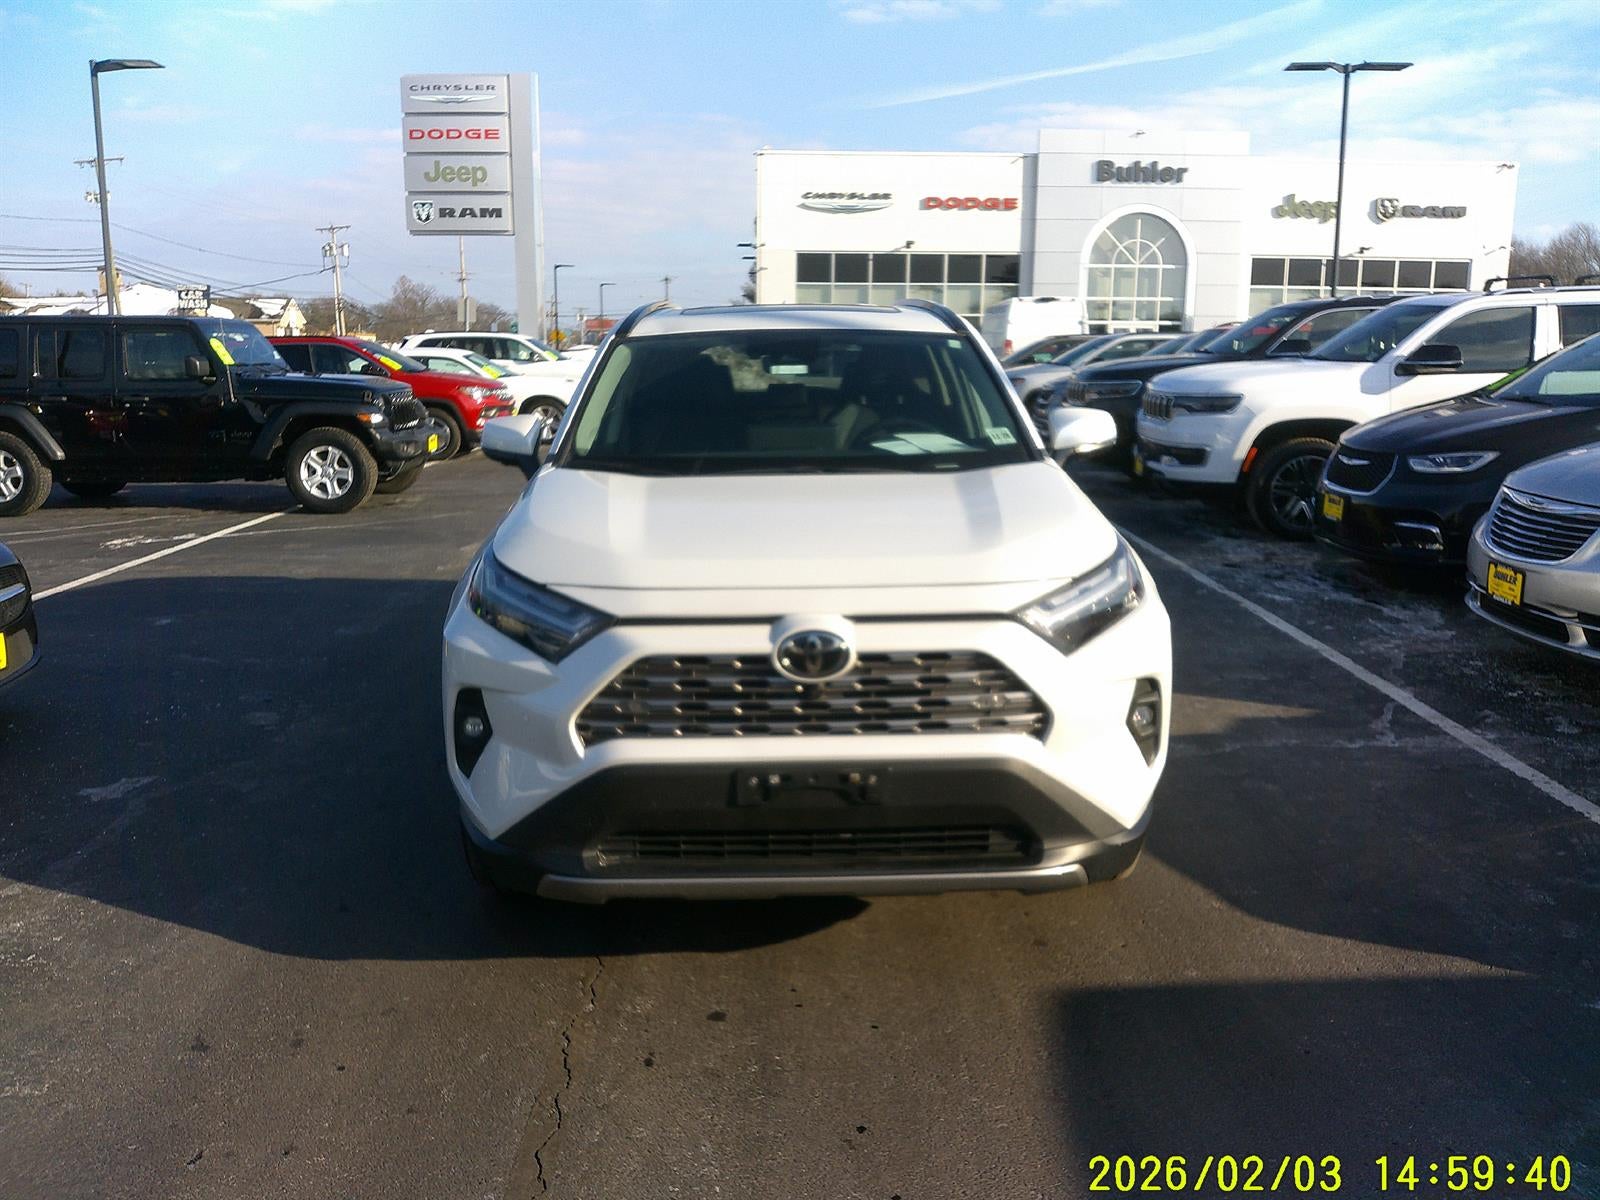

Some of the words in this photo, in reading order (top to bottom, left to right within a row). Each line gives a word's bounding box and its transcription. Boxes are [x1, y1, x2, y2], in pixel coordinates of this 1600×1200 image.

[409, 129, 500, 139] DODGE
[424, 160, 487, 186] Jeep
[1094, 159, 1189, 184] Buhler
[800, 190, 893, 200] CHRYSLER
[920, 196, 1019, 211] DODGE
[439, 207, 502, 217] RAM
[1402, 205, 1467, 218] RAM
[180, 290, 203, 299] CAR
[179, 299, 207, 308] WASH
